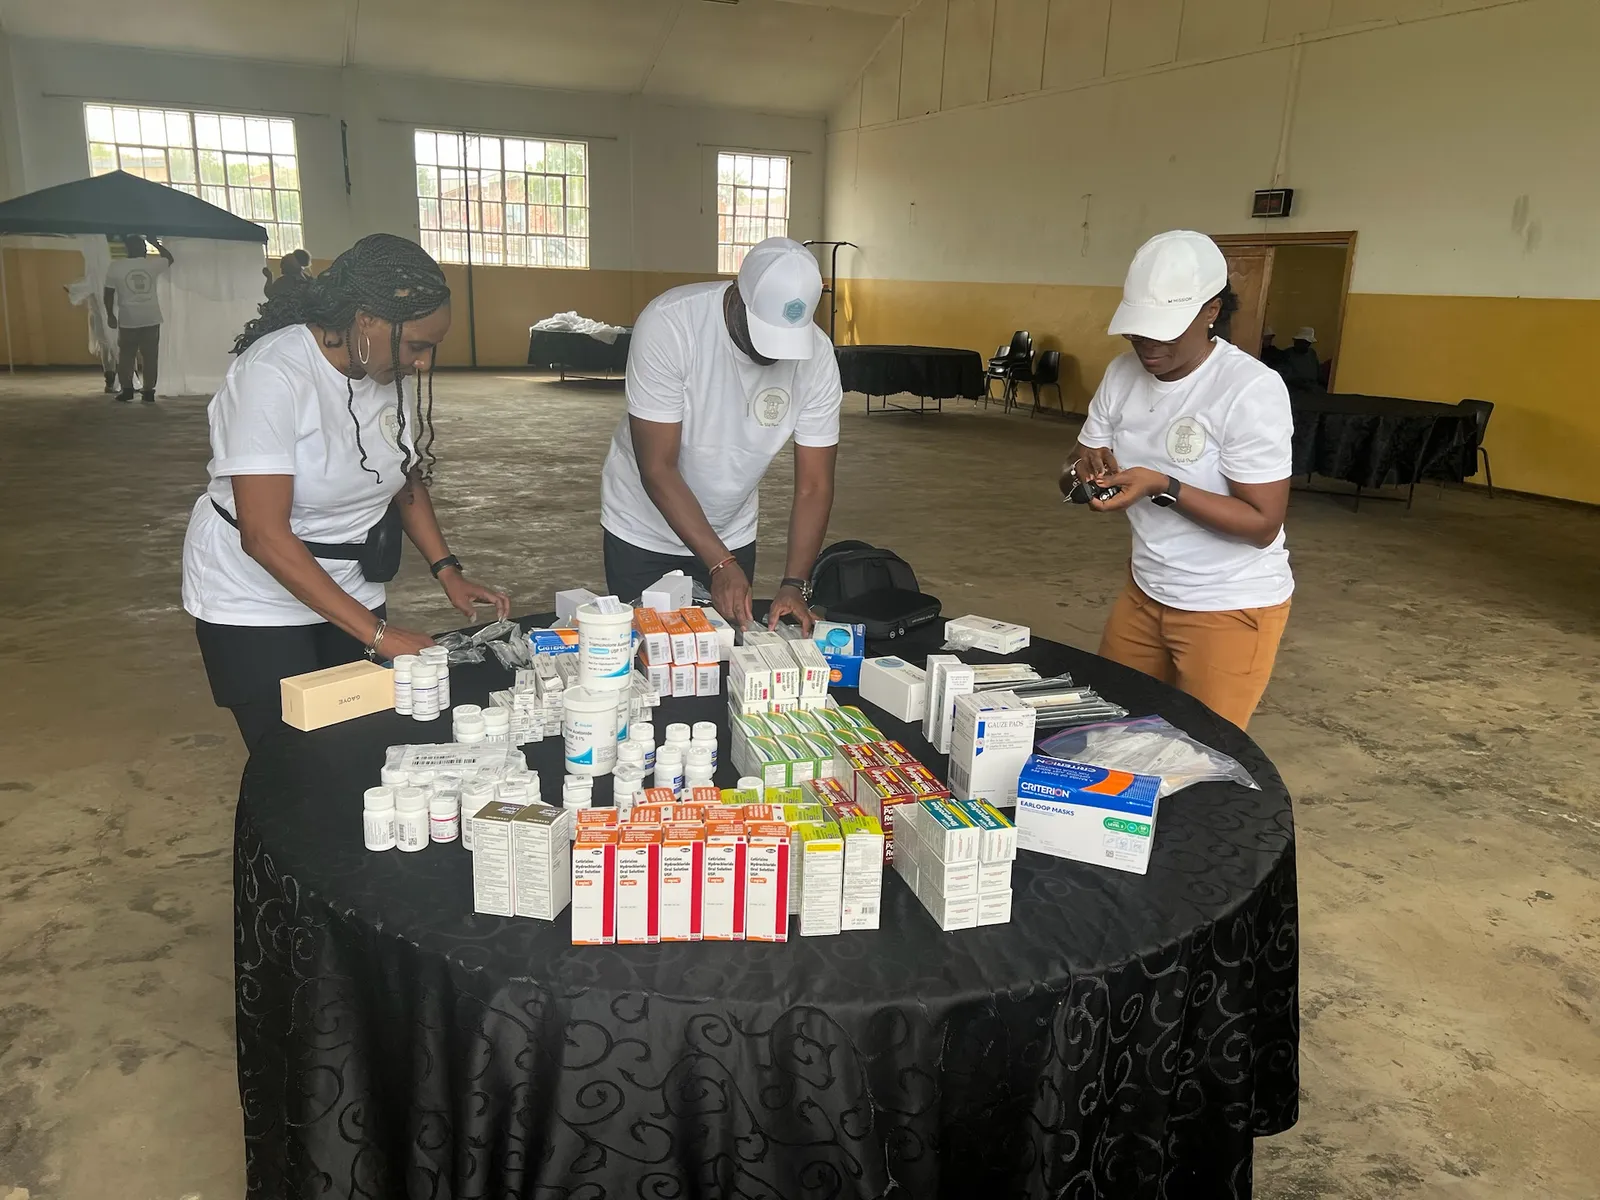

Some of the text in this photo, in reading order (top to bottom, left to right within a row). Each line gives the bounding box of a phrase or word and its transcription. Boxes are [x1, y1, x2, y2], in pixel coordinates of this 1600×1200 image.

[1035, 759, 1096, 773] CRITERION
[1021, 781, 1070, 798] CRITERION
[1020, 800, 1075, 816] EARLOOP MASKS
